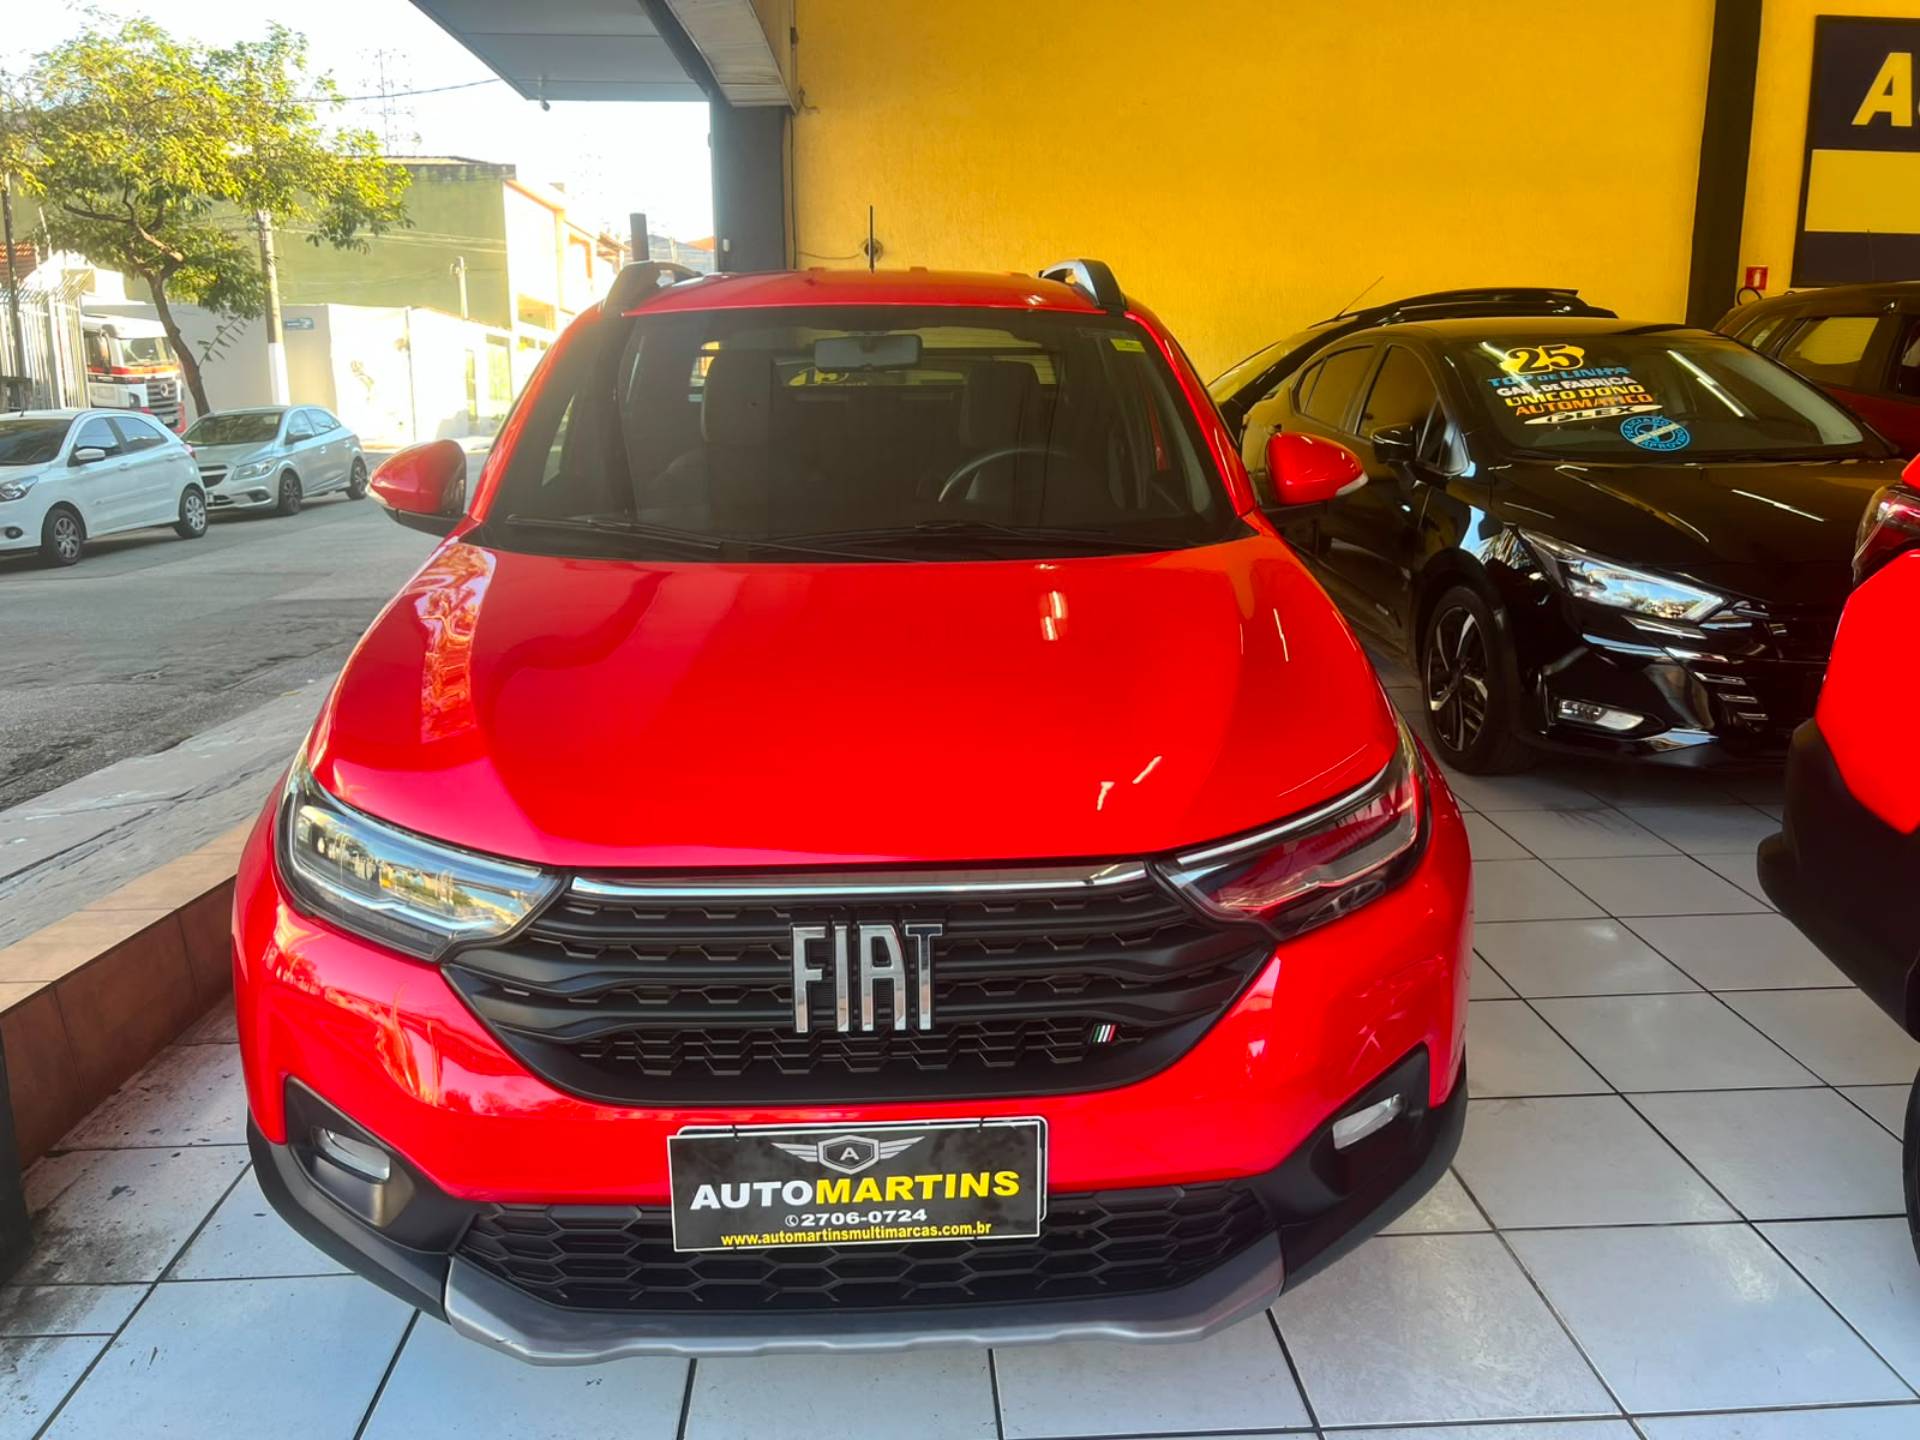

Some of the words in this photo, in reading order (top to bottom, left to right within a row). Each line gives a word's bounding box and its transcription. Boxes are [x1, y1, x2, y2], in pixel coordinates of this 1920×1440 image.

[1851, 52, 1920, 126] A
[1503, 344, 1583, 373] 25
[1488, 375, 1533, 387] TOP
[1560, 367, 1630, 379] LINHA
[1541, 383, 1562, 392] DE
[1560, 376, 1638, 389] FABRICA
[1504, 391, 1577, 407] UNICO
[1578, 385, 1646, 398] DONO
[1516, 394, 1654, 416] AUTOMATICO
[1546, 405, 1635, 424] FLEX
[793, 924, 943, 1033] FIAT
[840, 1147, 860, 1161] A
[690, 1171, 1020, 1210] AUTOMARTINS
[801, 1208, 928, 1227] 2706-0724
[720, 1220, 992, 1246] www.automartinsmultimarcas.com.br
